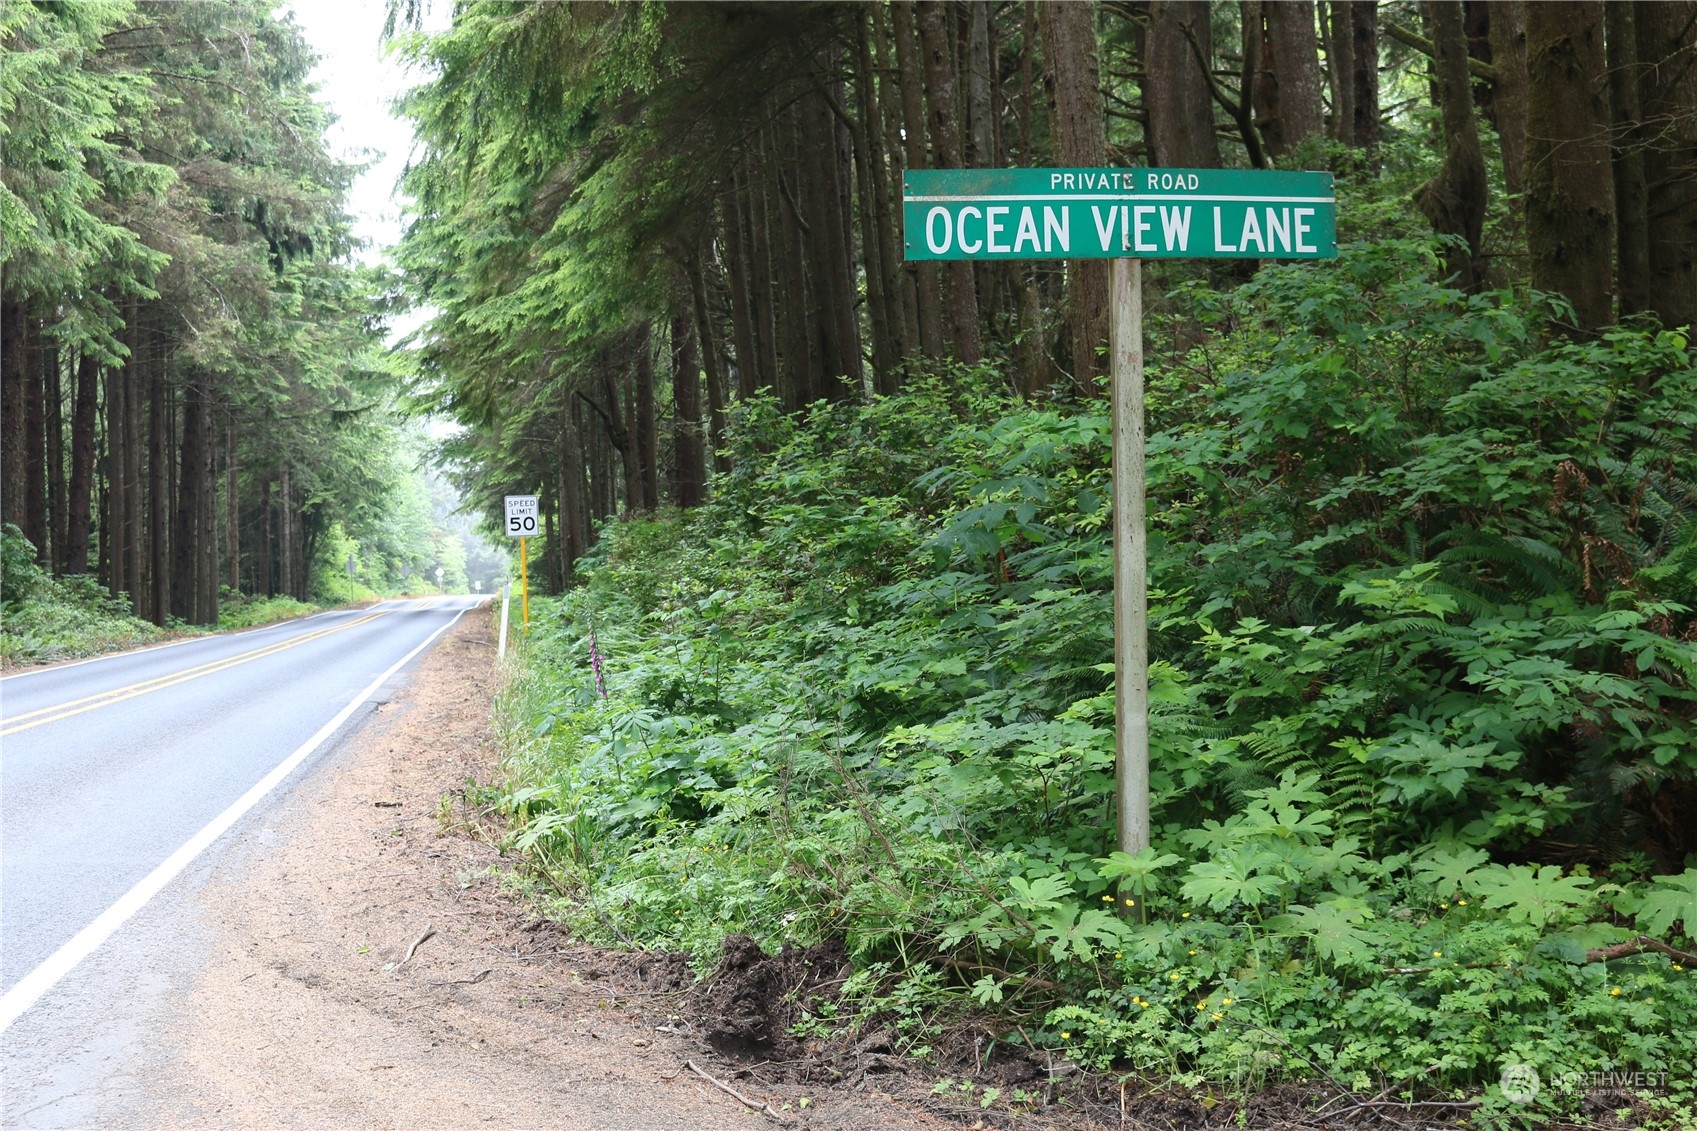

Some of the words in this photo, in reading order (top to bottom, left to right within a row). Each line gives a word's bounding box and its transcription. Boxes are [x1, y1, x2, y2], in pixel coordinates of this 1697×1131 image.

[1050, 173, 1135, 190] PRIVATE
[1148, 173, 1199, 190] ROAD
[925, 205, 1070, 255] OCEAN
[1091, 205, 1192, 252] VIEW
[1214, 206, 1318, 253] LANE
[511, 508, 532, 516] LIMIT
[510, 516, 536, 532] 50
